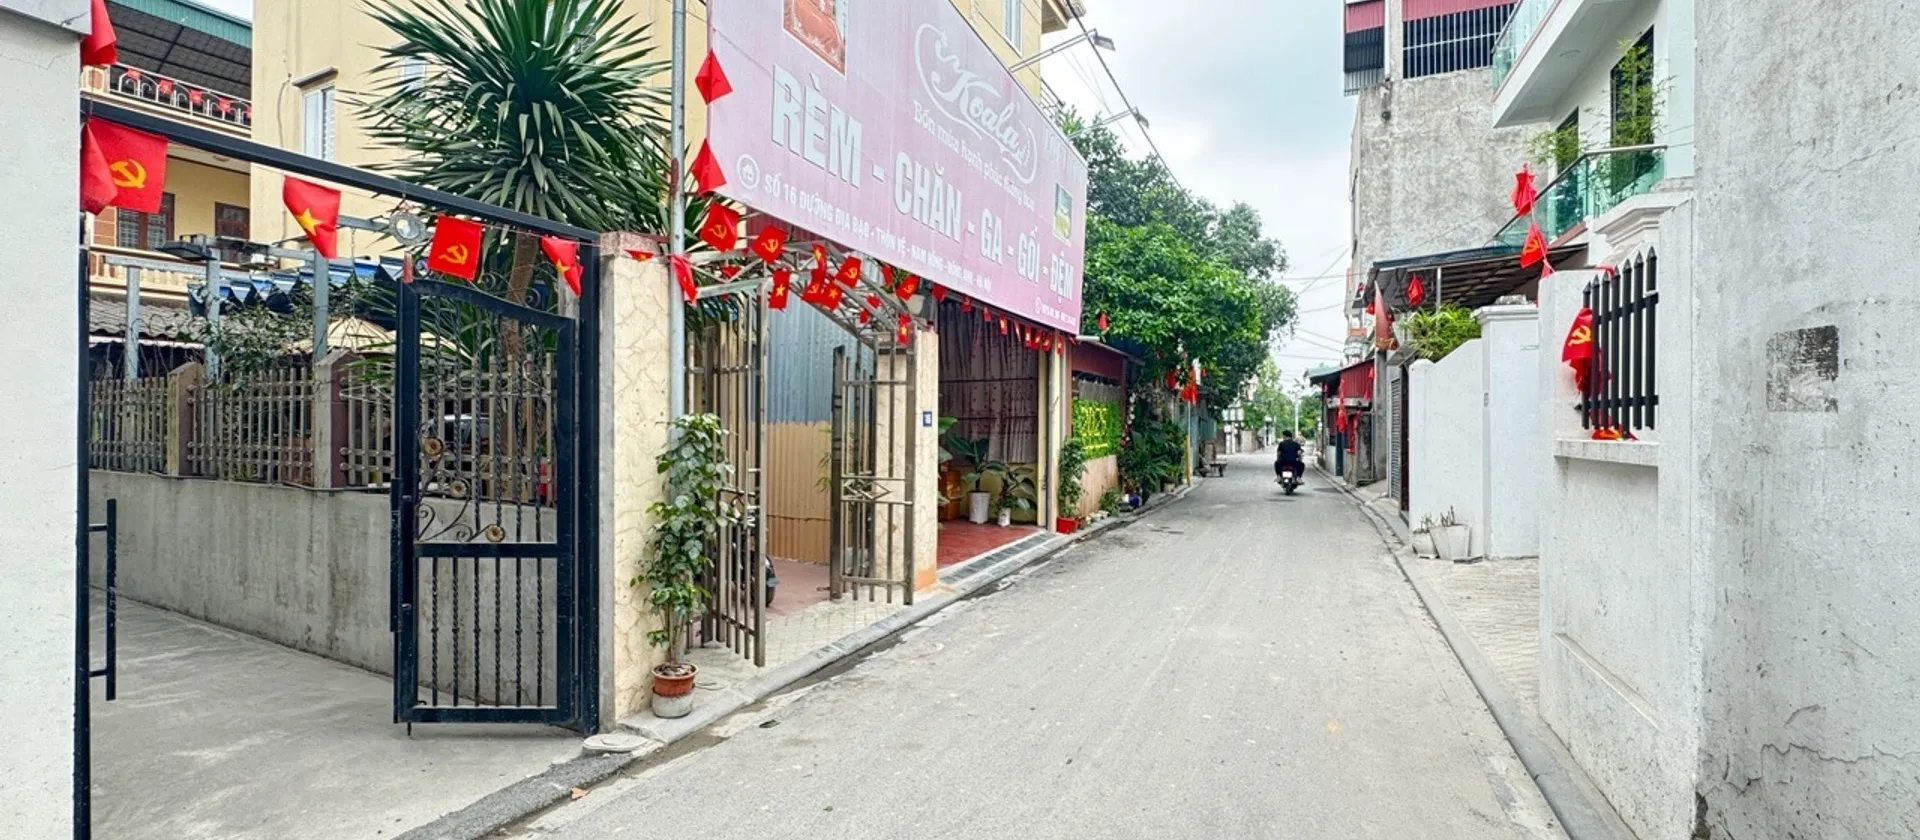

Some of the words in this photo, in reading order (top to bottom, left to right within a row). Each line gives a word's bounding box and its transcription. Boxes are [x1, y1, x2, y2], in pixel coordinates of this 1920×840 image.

[913, 100, 935, 135] Bốn
[764, 172, 781, 198] SỐ
[784, 183, 797, 205] 16
[800, 191, 833, 224] ĐƯỜNG
[772, 63, 861, 189] RÈM
[894, 151, 962, 243] CHĂN
[980, 208, 1002, 265] GA
[1017, 226, 1040, 284] GỐI
[1049, 251, 1073, 304] ĐỆM
